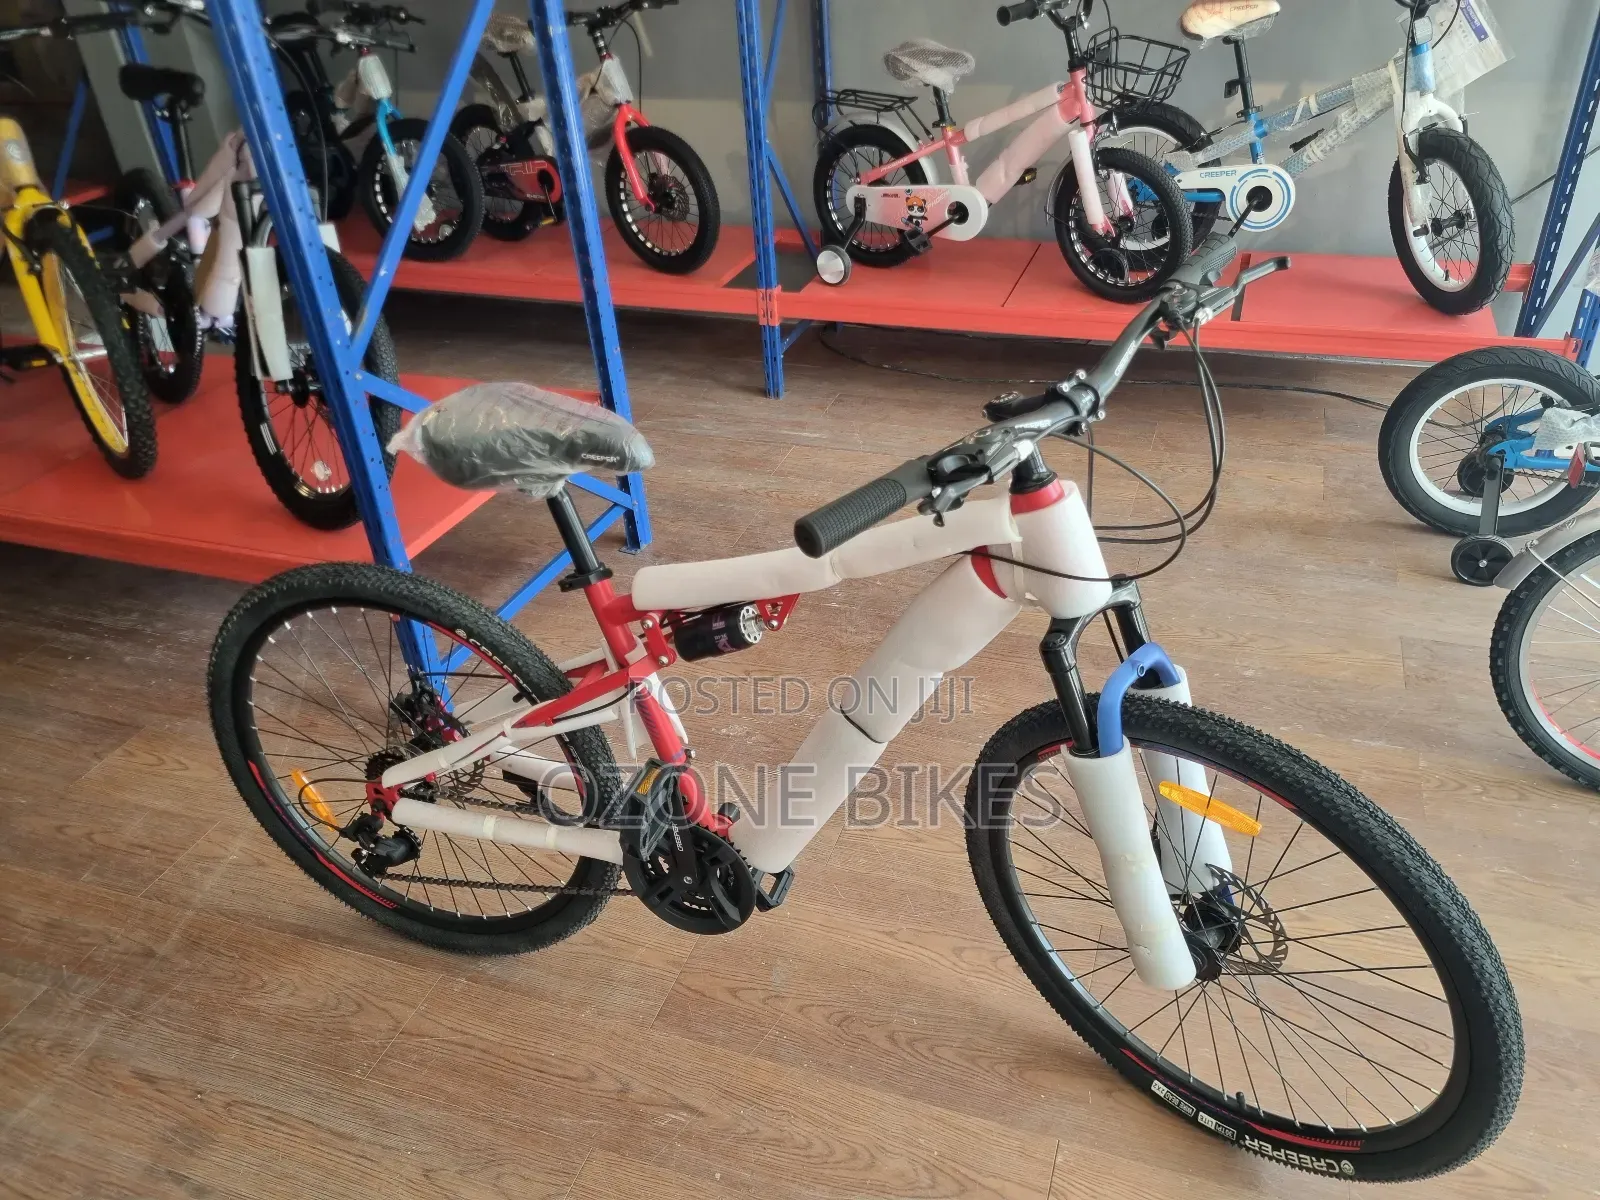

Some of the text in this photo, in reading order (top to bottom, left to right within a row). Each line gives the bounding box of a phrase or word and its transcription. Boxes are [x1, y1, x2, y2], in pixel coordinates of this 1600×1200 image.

[1199, 169, 1237, 179] CREEPER
[581, 453, 617, 463] CREEPER
[1244, 1134, 1340, 1173] CREEPER
